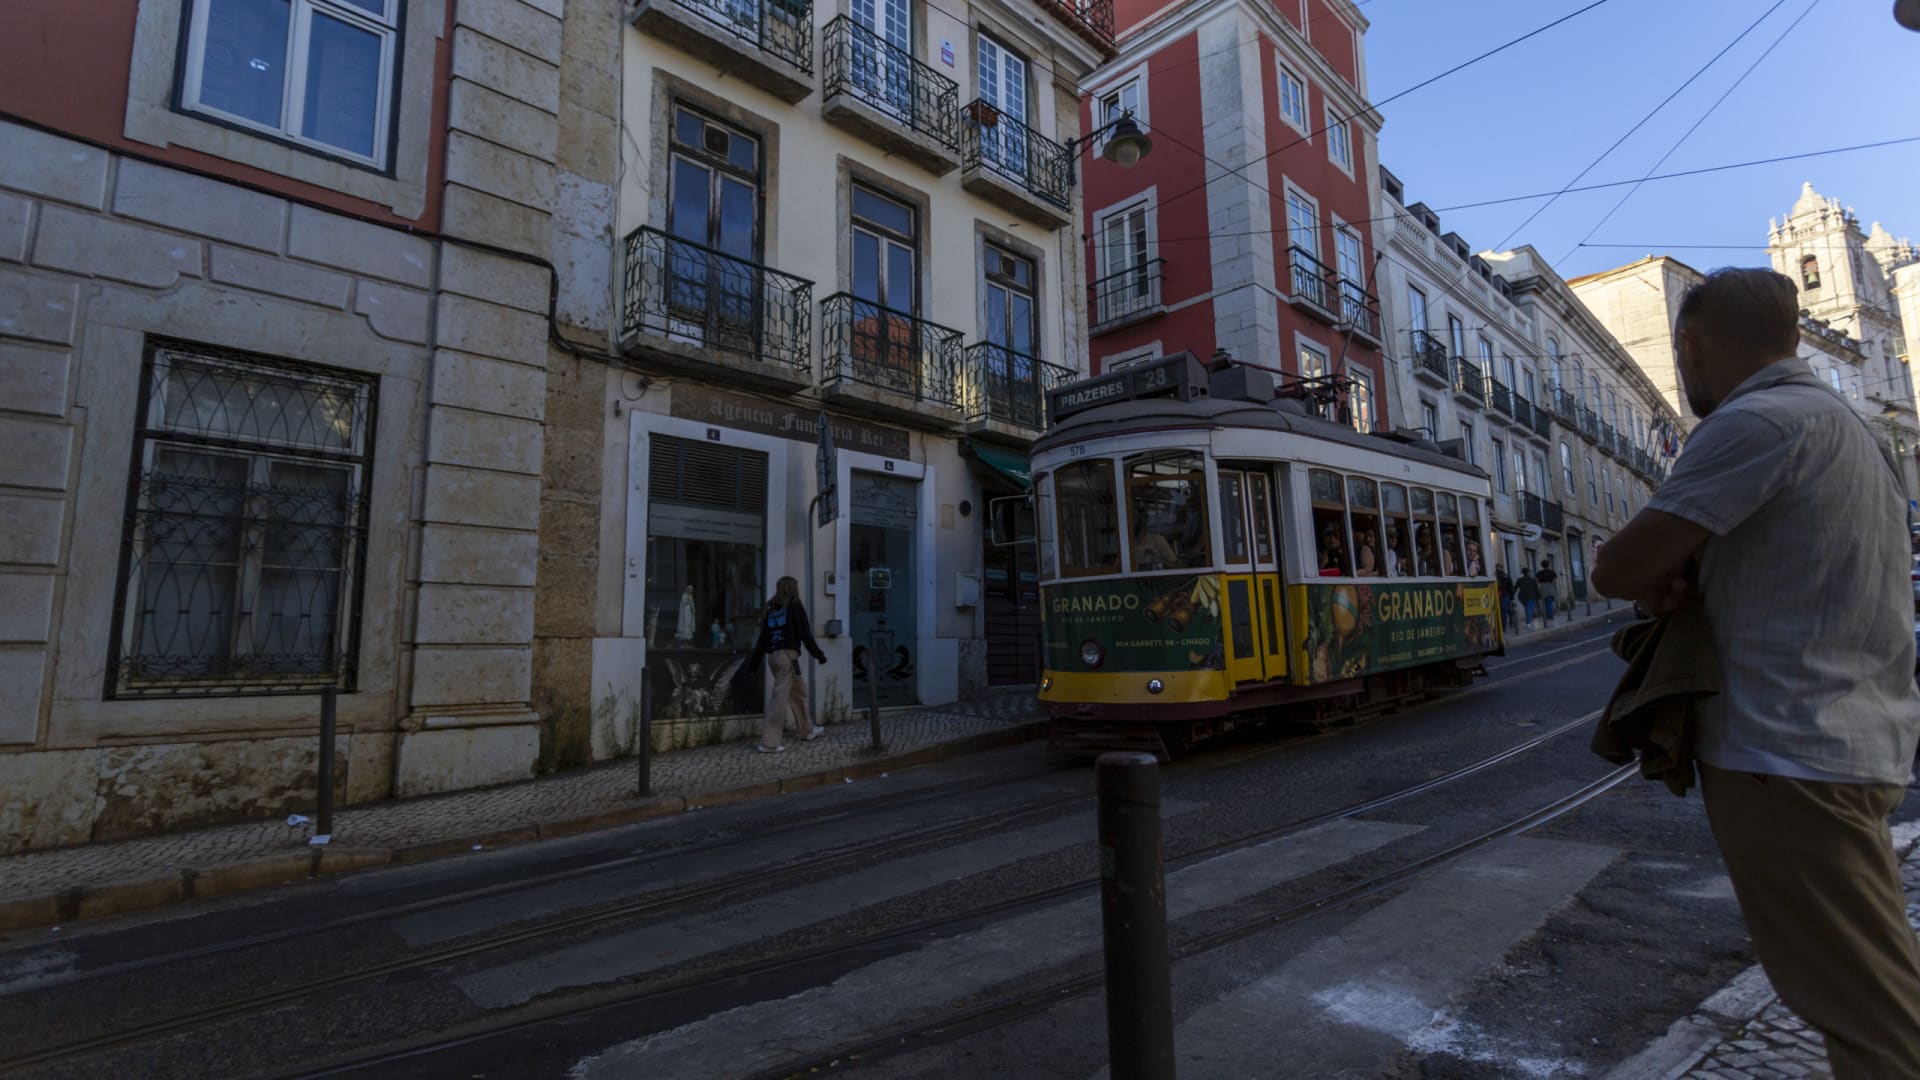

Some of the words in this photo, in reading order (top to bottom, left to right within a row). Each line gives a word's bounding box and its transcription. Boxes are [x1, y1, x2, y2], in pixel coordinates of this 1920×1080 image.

[1060, 381, 1125, 409] PRAZERES
[1144, 367, 1167, 389] 28
[708, 396, 774, 425] Agência
[860, 427, 884, 447] Rei
[1070, 445, 1086, 457] 578
[1052, 593, 1140, 613] GRANADO
[1378, 589, 1455, 622] GRANADO
[1085, 615, 1125, 624] JANEIRO
[1181, 637, 1210, 646] CHIADO
[1391, 631, 1404, 642] RIO
[1406, 629, 1416, 640] DE
[1418, 625, 1445, 639] JANEIRO
